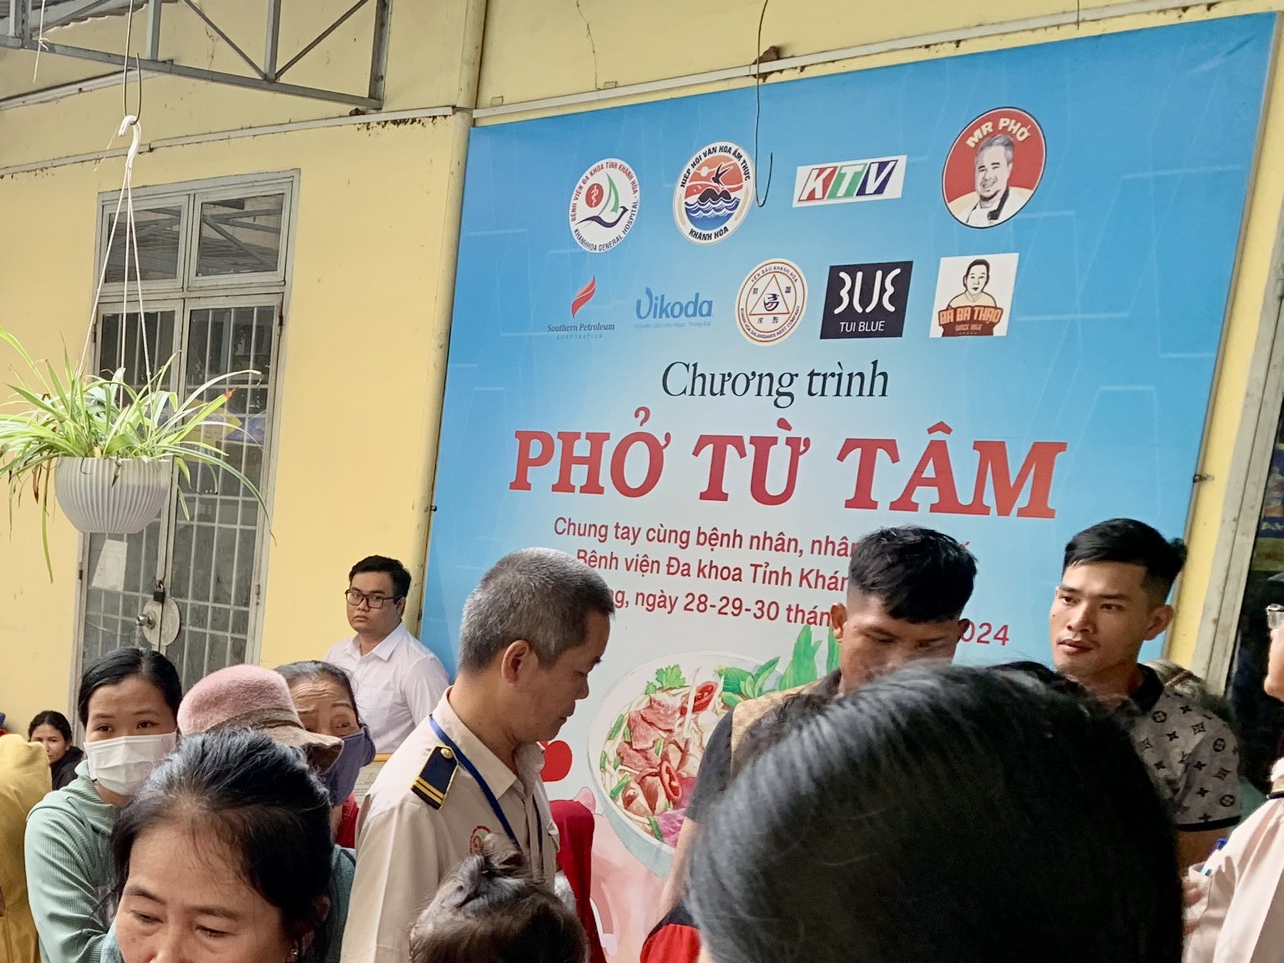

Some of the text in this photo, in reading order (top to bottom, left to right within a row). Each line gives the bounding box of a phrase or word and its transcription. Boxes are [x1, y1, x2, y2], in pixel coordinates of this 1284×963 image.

[966, 121, 993, 148] MR
[799, 160, 898, 202] KTV
[622, 199, 638, 236] HOSPITAL
[635, 286, 714, 320] Vikoda
[547, 322, 615, 332] Southern Petroleum
[839, 320, 886, 333] TUI BLUE
[661, 360, 890, 409] Chương trình
[508, 406, 1069, 520] PHỞ TỪ TÂM
[554, 516, 609, 543] Chung
[614, 522, 642, 546] tay
[645, 523, 691, 550] cùng
[695, 526, 743, 552] bệnh
[749, 531, 804, 558] nhân,
[624, 553, 661, 577] viện
[665, 556, 692, 577] Đa
[697, 558, 743, 582] khoa
[749, 561, 793, 588] Tỉnh
[635, 590, 679, 615] ngày
[683, 592, 780, 622] 28-29-30
[960, 621, 1010, 646] 024
